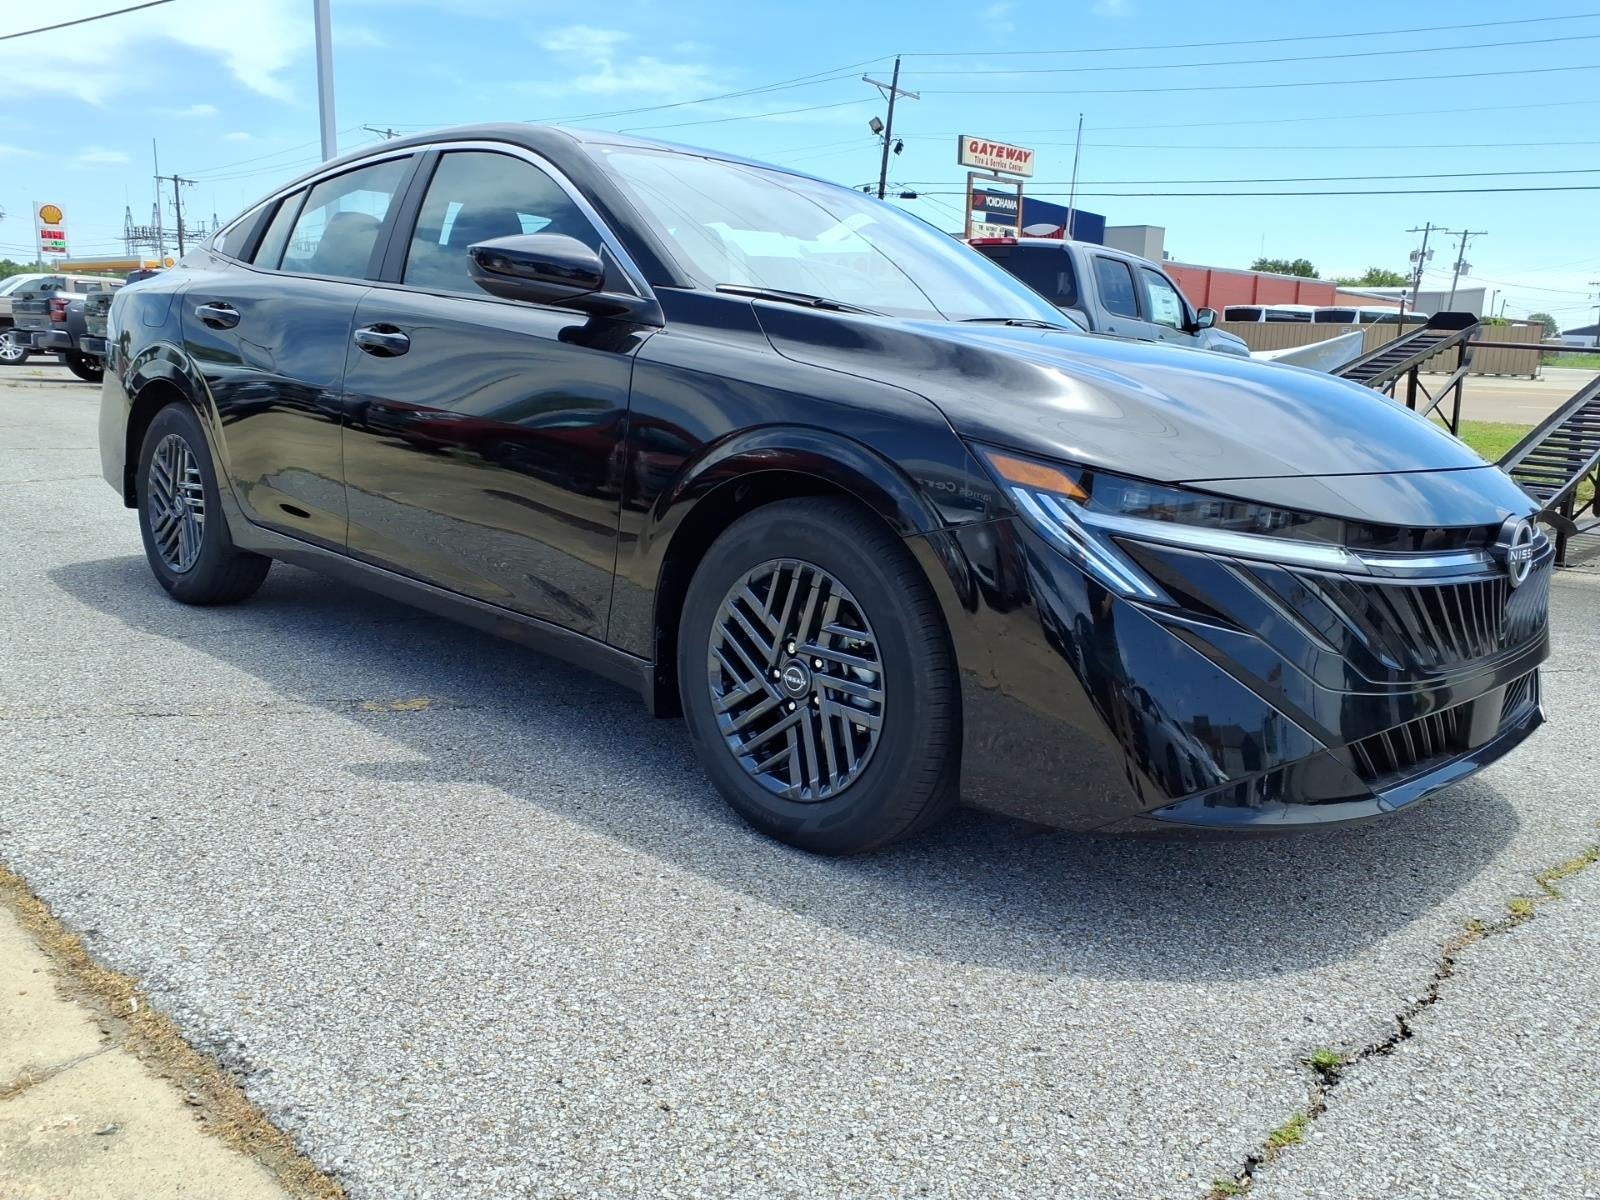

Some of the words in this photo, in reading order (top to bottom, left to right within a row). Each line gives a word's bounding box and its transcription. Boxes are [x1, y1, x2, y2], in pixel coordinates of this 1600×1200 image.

[969, 141, 1031, 163] GATEWAY
[975, 156, 984, 164] Tire
[991, 159, 1007, 169] Service
[1009, 162, 1023, 171] Center
[985, 196, 1018, 209] YOKOHAMA
